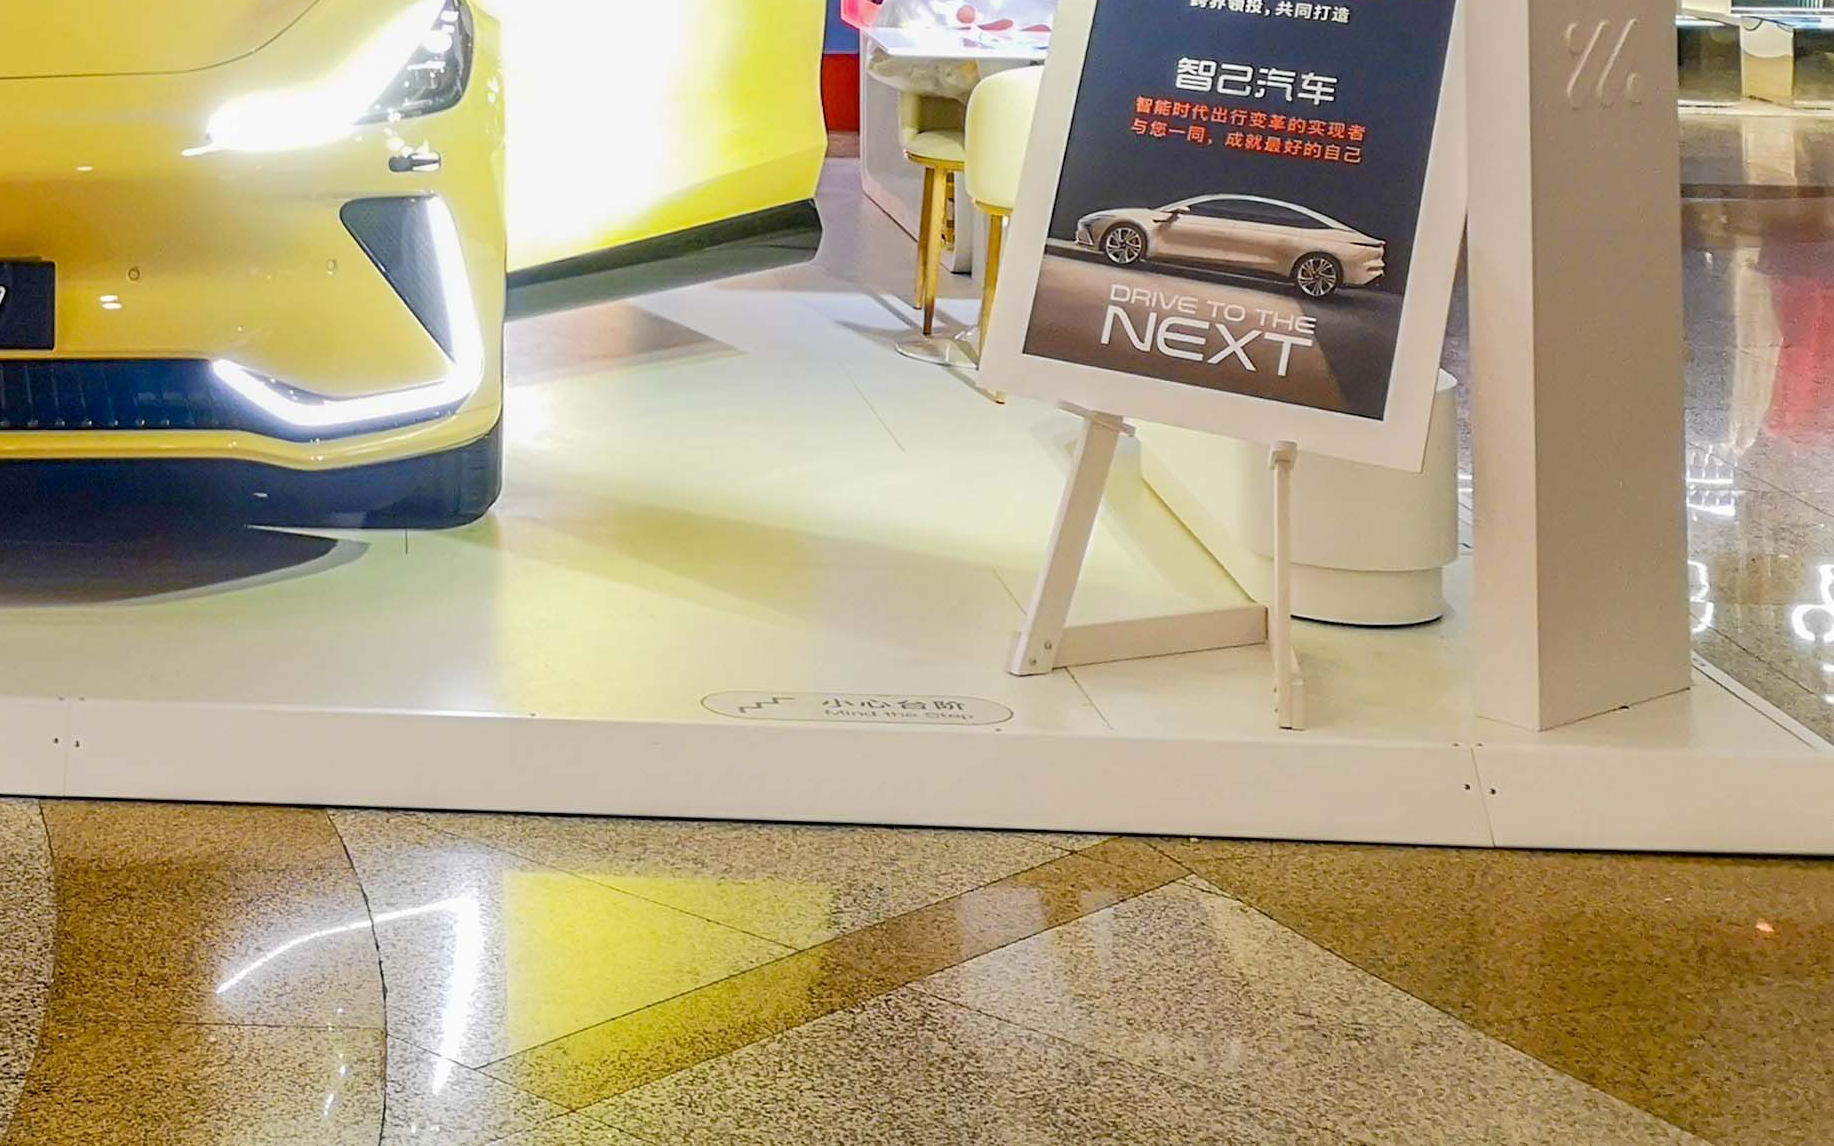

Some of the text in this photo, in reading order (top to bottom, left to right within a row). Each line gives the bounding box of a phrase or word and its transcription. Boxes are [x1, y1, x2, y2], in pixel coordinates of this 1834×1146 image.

[1175, 57, 1338, 105] 智己汽车
[1135, 96, 1366, 142] 智能时代出行变革的实现者
[1110, 284, 1316, 335] DRIVE TO THE
[1100, 304, 1313, 377] NEXT
